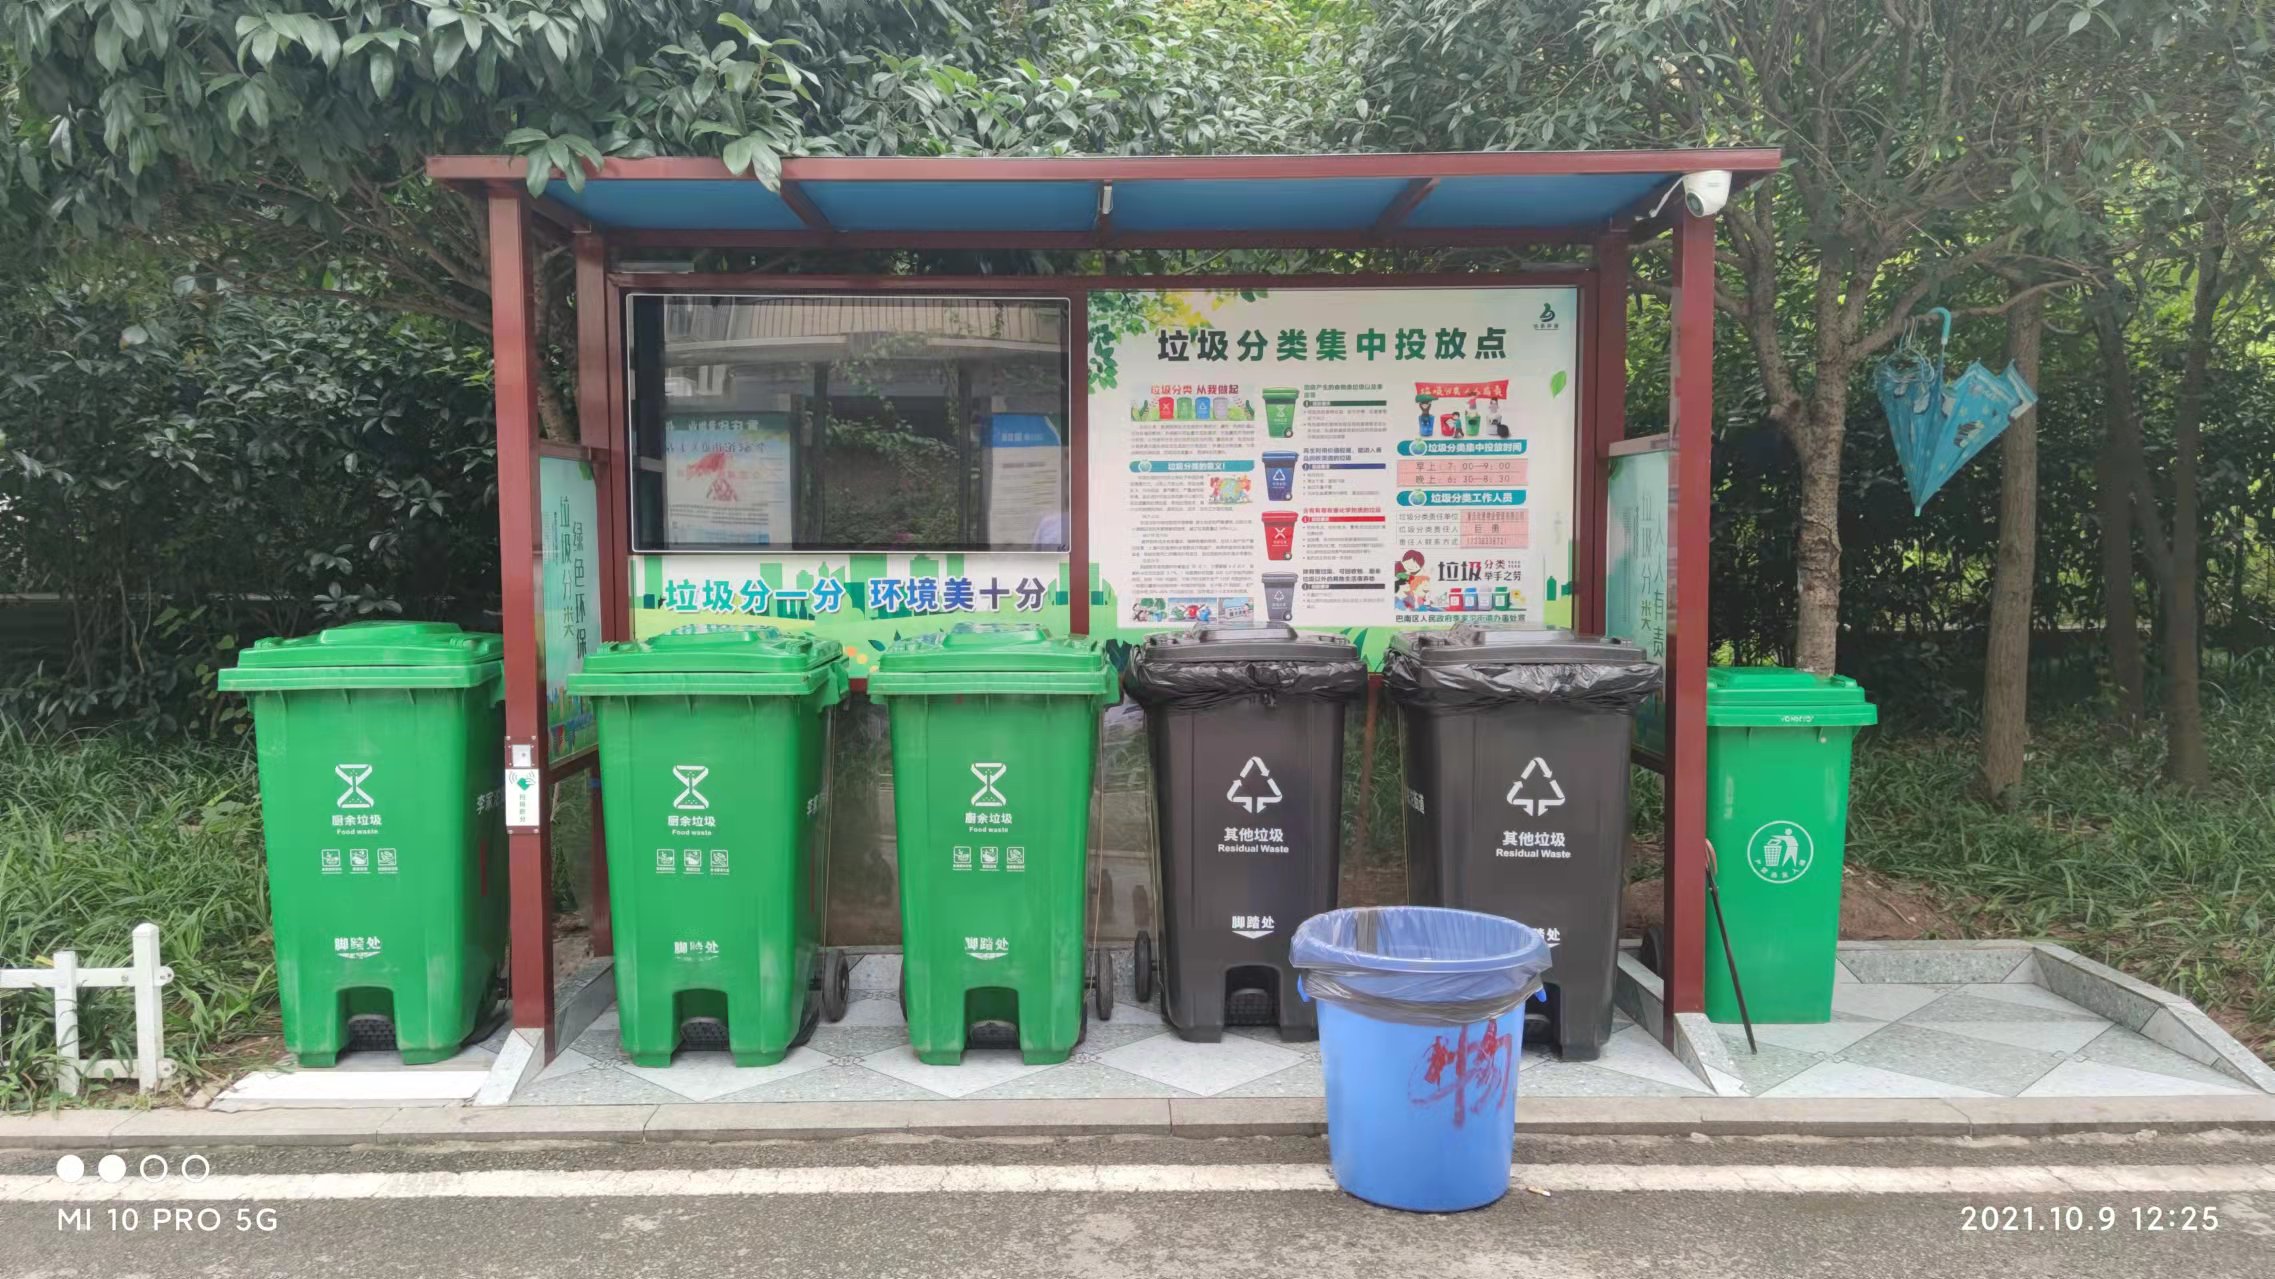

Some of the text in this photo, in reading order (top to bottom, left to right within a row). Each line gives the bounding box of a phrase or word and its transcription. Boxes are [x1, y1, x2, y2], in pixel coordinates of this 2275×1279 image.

[1157, 327, 1507, 362] 垃圾分类集中投放点
[1151, 384, 1239, 395] 垃圾分类 从我做起
[1428, 442, 1521, 453] 垃圾分类集中投放时间
[1430, 492, 1513, 504] 垃圾分类工作人员
[558, 495, 575, 638] 垃圾分类
[1641, 493, 1653, 632] 垃圾分类
[1438, 561, 1482, 582] 垃圾
[1484, 560, 1505, 569] 分类
[1484, 571, 1522, 581] 举手之劳
[572, 521, 588, 659] 绿色环保
[1653, 510, 1664, 658] 人人有责
[664, 578, 1047, 613] 垃圾分一分 环境美十分
[332, 815, 382, 826] 厨余垃圾
[668, 815, 716, 827] 厨余垃圾
[965, 812, 1013, 824] 厨余垃圾
[1224, 828, 1283, 842] 其他垃圾
[1502, 831, 1566, 847] 其他垃圾
[1218, 844, 1289, 853] Residual Waste
[1496, 849, 1571, 858] Residual Waste
[1232, 915, 1275, 929] 脚踏处
